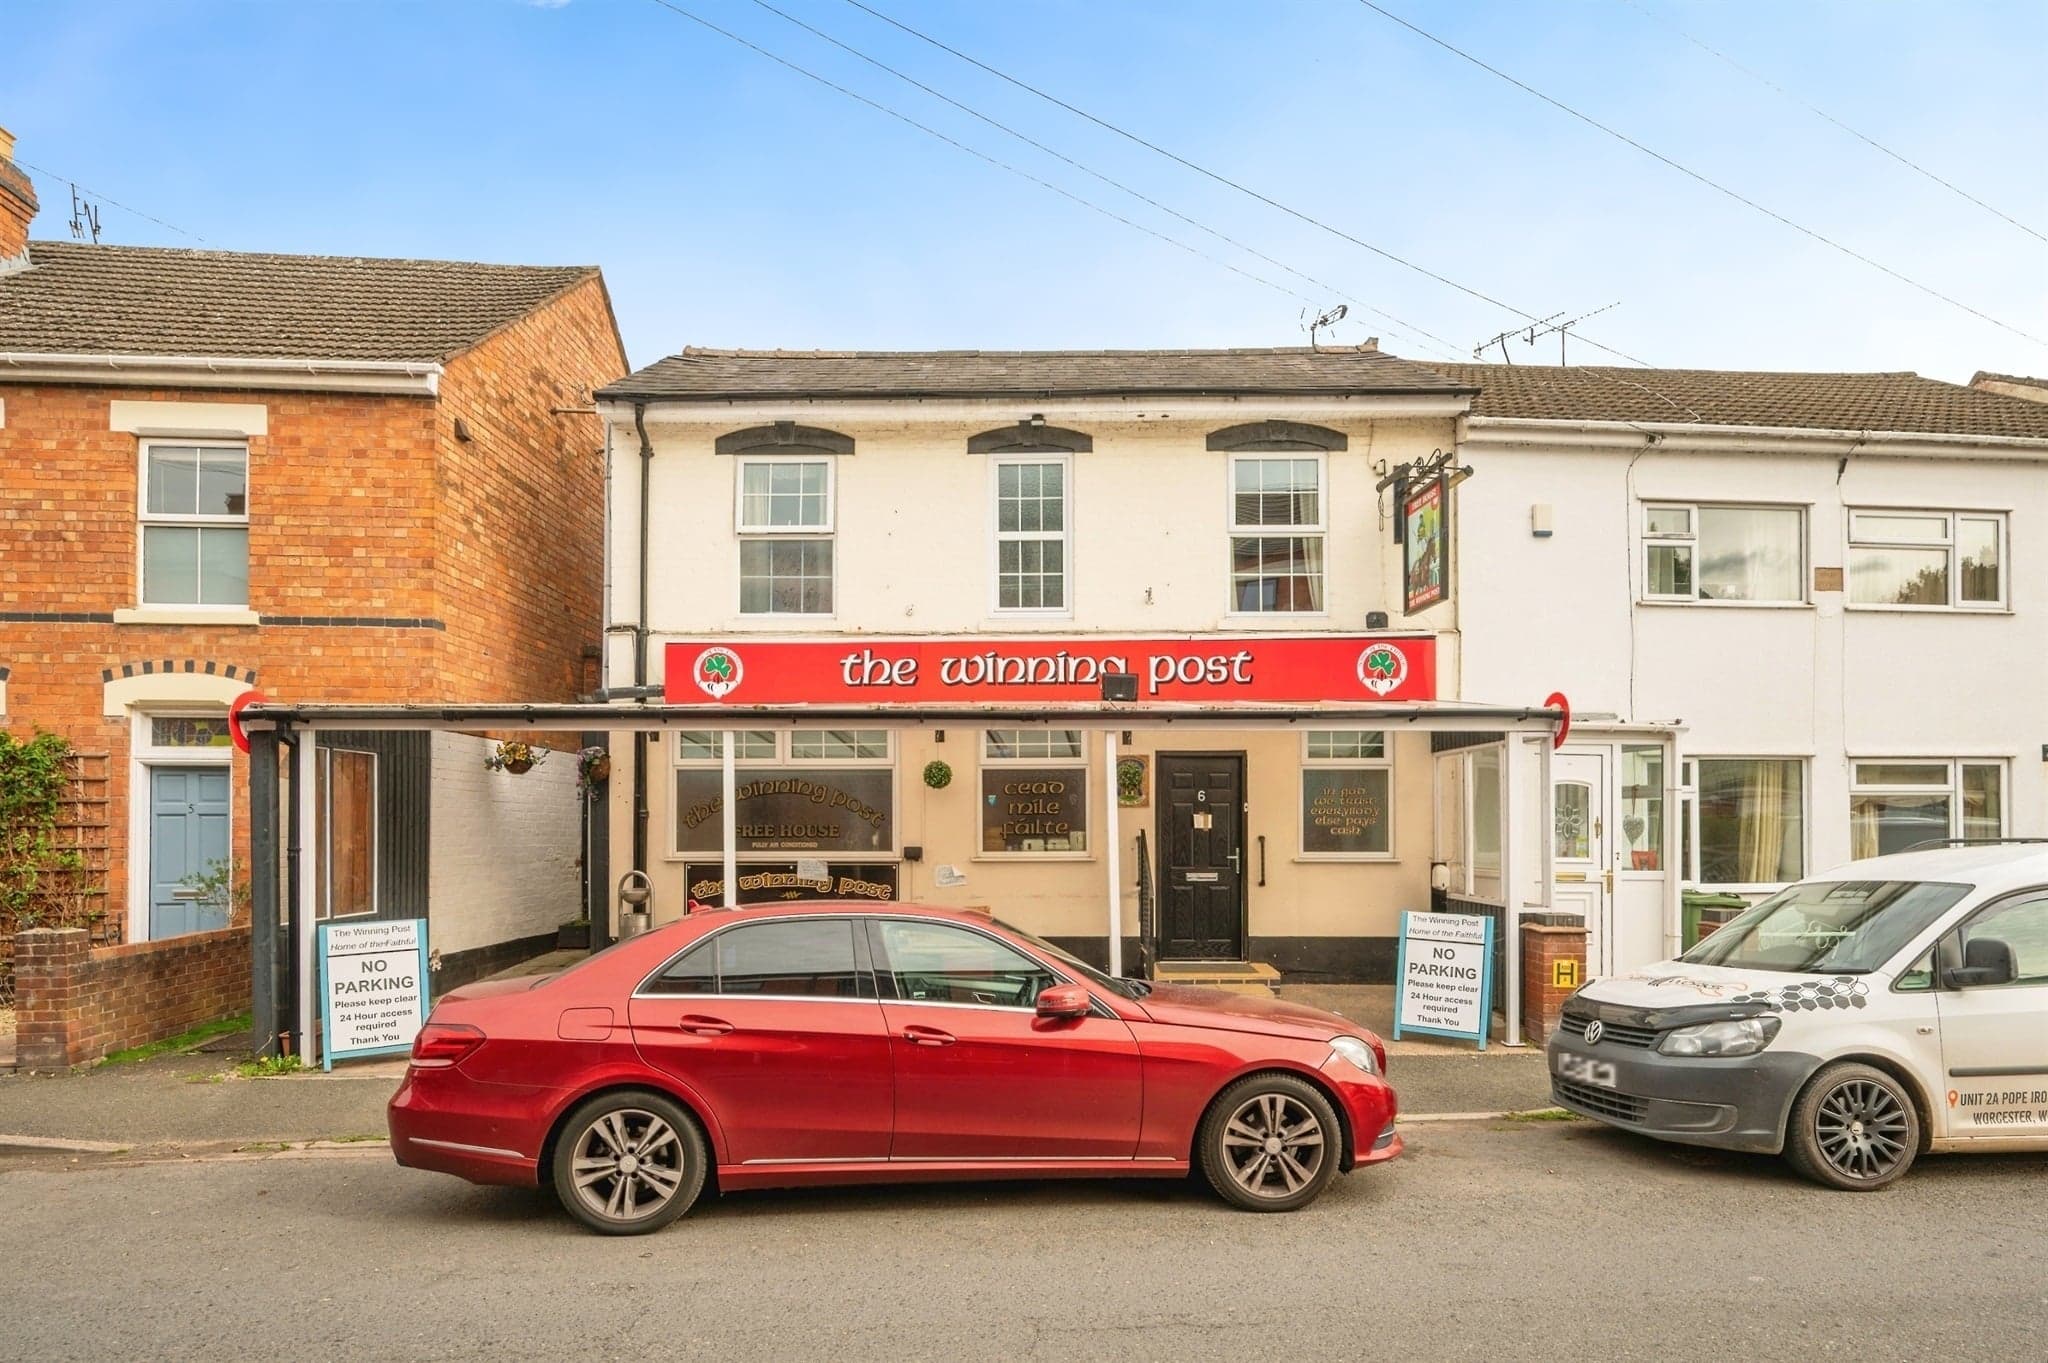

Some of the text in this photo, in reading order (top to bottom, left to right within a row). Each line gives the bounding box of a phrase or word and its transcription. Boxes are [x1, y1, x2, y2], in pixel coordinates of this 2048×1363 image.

[840, 649, 919, 687] the
[1149, 650, 1253, 695] post
[1004, 781, 1064, 795] cead
[1197, 790, 1206, 801] 6
[684, 796, 724, 829] the
[831, 788, 886, 828] post
[1346, 817, 1377, 827] pays
[780, 823, 841, 838] HOUSE
[839, 877, 893, 900] post
[1428, 917, 1460, 926] Winning
[1461, 918, 1479, 927] Post
[333, 925, 411, 937] The Winning Post
[1408, 927, 1483, 939] Home of the Faithful
[330, 938, 416, 951] Home of the Faithful
[1433, 947, 1455, 960] NO
[361, 959, 387, 973] NO
[1409, 962, 1477, 980] PARKING
[1557, 963, 1574, 985] H
[334, 976, 414, 995] PARKING
[1408, 979, 1479, 993] Please keep clear
[335, 994, 418, 1009] Please keep clear
[1422, 993, 1442, 1001] Hour
[1444, 997, 1473, 1006] access
[1422, 1003, 1458, 1014] required
[339, 1009, 413, 1022] 24 Hour access
[1417, 1014, 1460, 1026] Thank You
[355, 1020, 397, 1031] required
[350, 1034, 400, 1045] Thank You
[1961, 1093, 1984, 1106] UNIT
[1986, 1092, 1999, 1105] 2A
[2002, 1091, 2028, 1104] POPE
[1973, 1110, 2036, 1125] WORCESTER,
